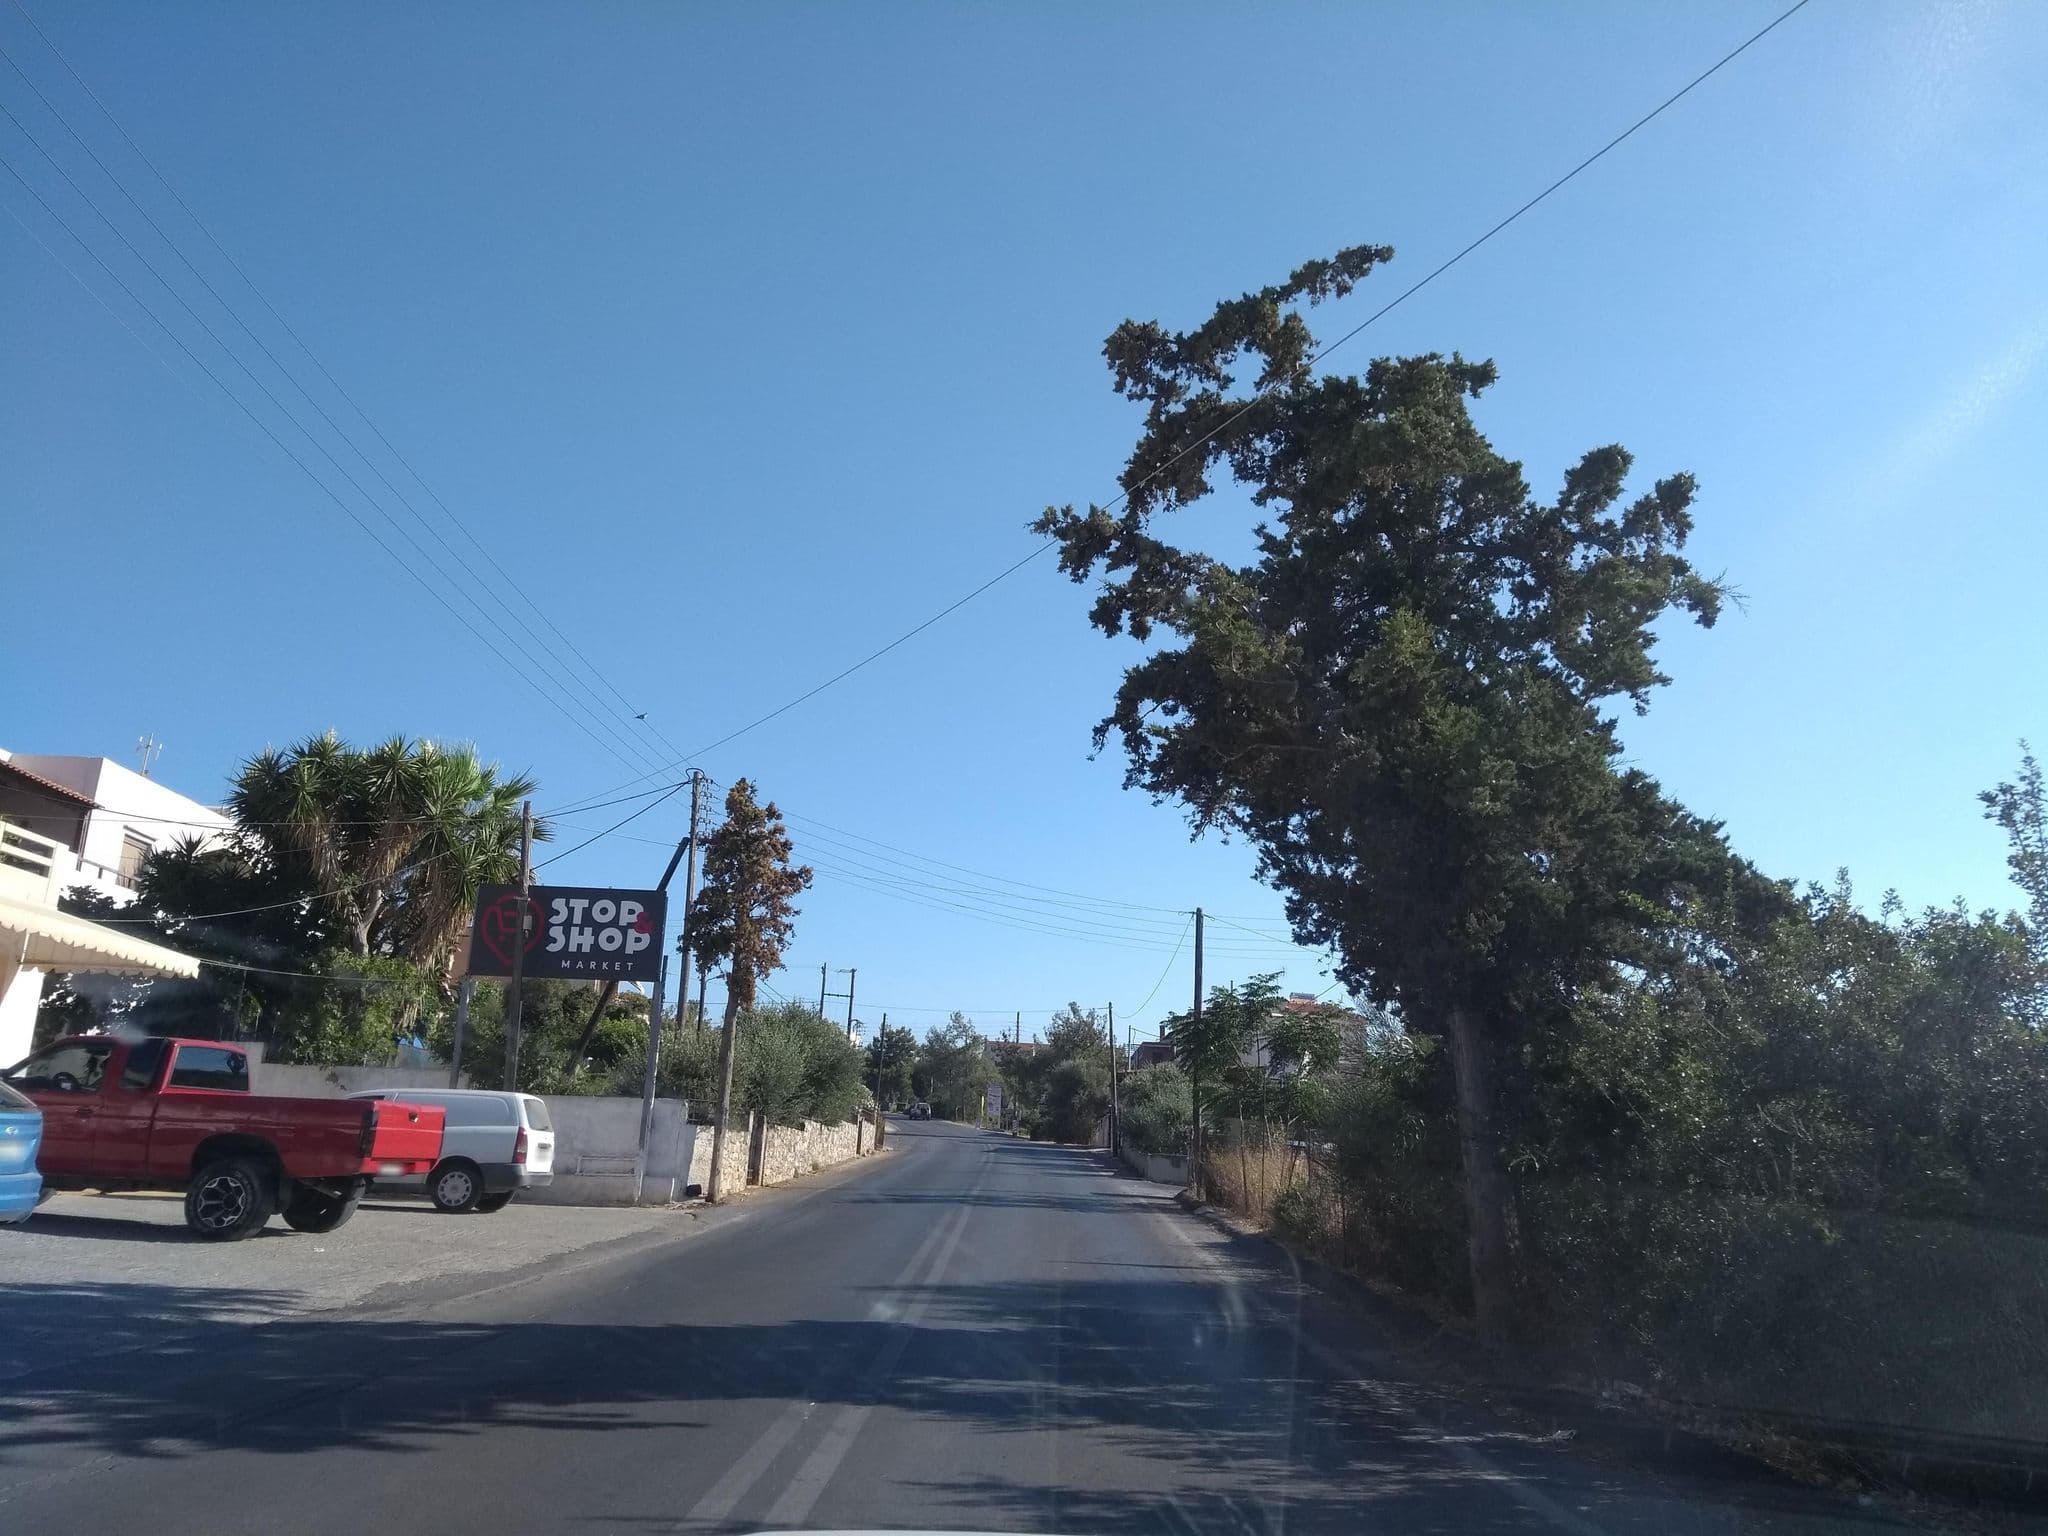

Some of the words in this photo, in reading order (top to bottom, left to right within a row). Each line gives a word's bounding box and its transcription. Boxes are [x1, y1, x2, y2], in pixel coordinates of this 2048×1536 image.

[548, 898, 644, 926] STOP
[545, 926, 651, 954] SHOP
[561, 960, 634, 971] MARKET
